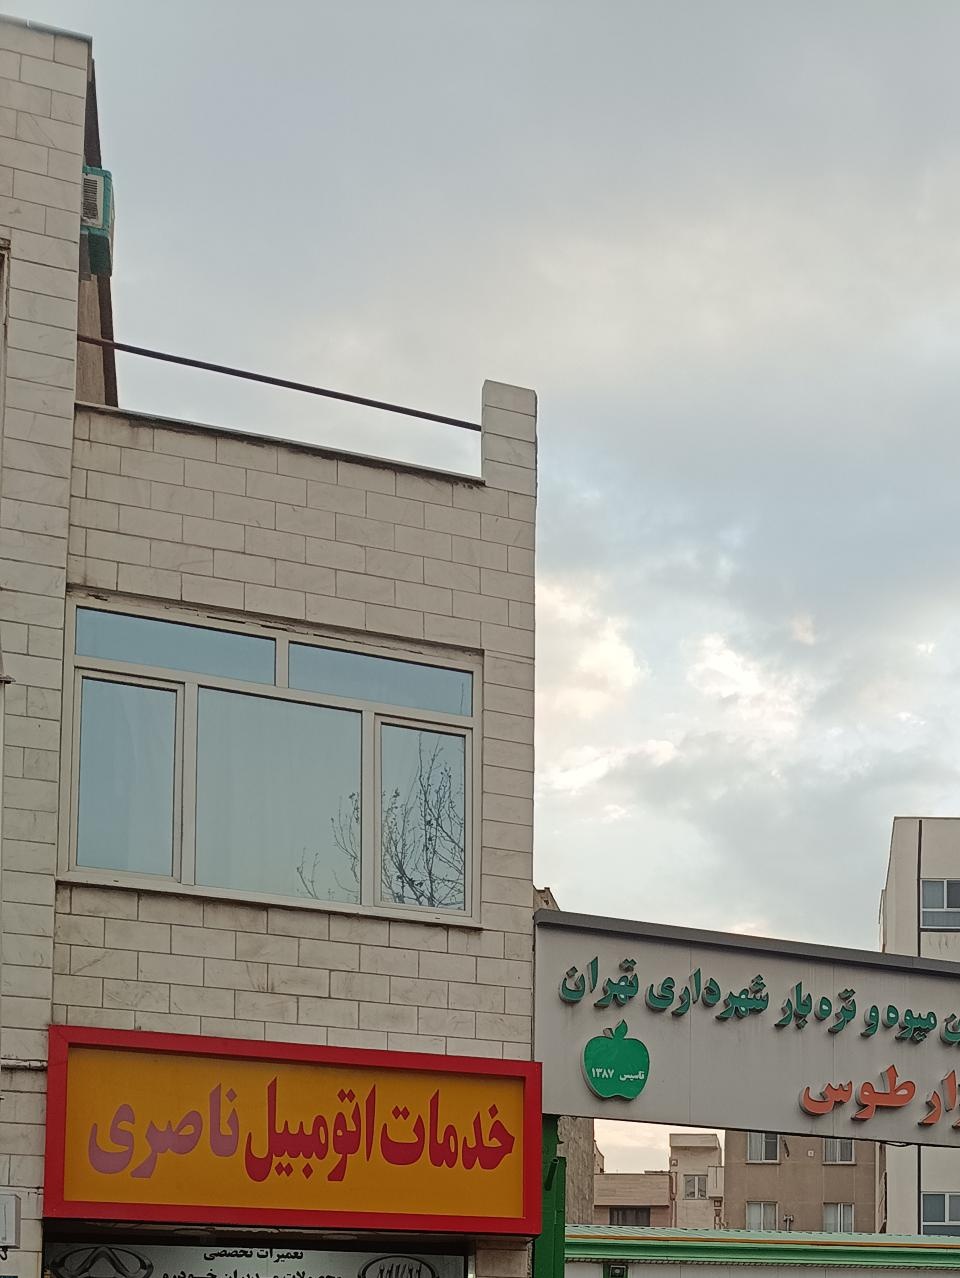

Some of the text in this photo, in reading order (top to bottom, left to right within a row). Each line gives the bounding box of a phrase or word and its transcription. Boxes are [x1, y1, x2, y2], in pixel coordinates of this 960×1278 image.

[559, 956, 639, 1009] تهران
[645, 967, 770, 1021] شهرداری
[860, 1004, 880, 1038] و
[881, 1004, 938, 1042] میوه
[592, 1067, 614, 1078] ۱۳۸۷
[800, 1064, 917, 1121] طوس
[87, 1076, 515, 1182] خدمات اتومبیل ناصری
